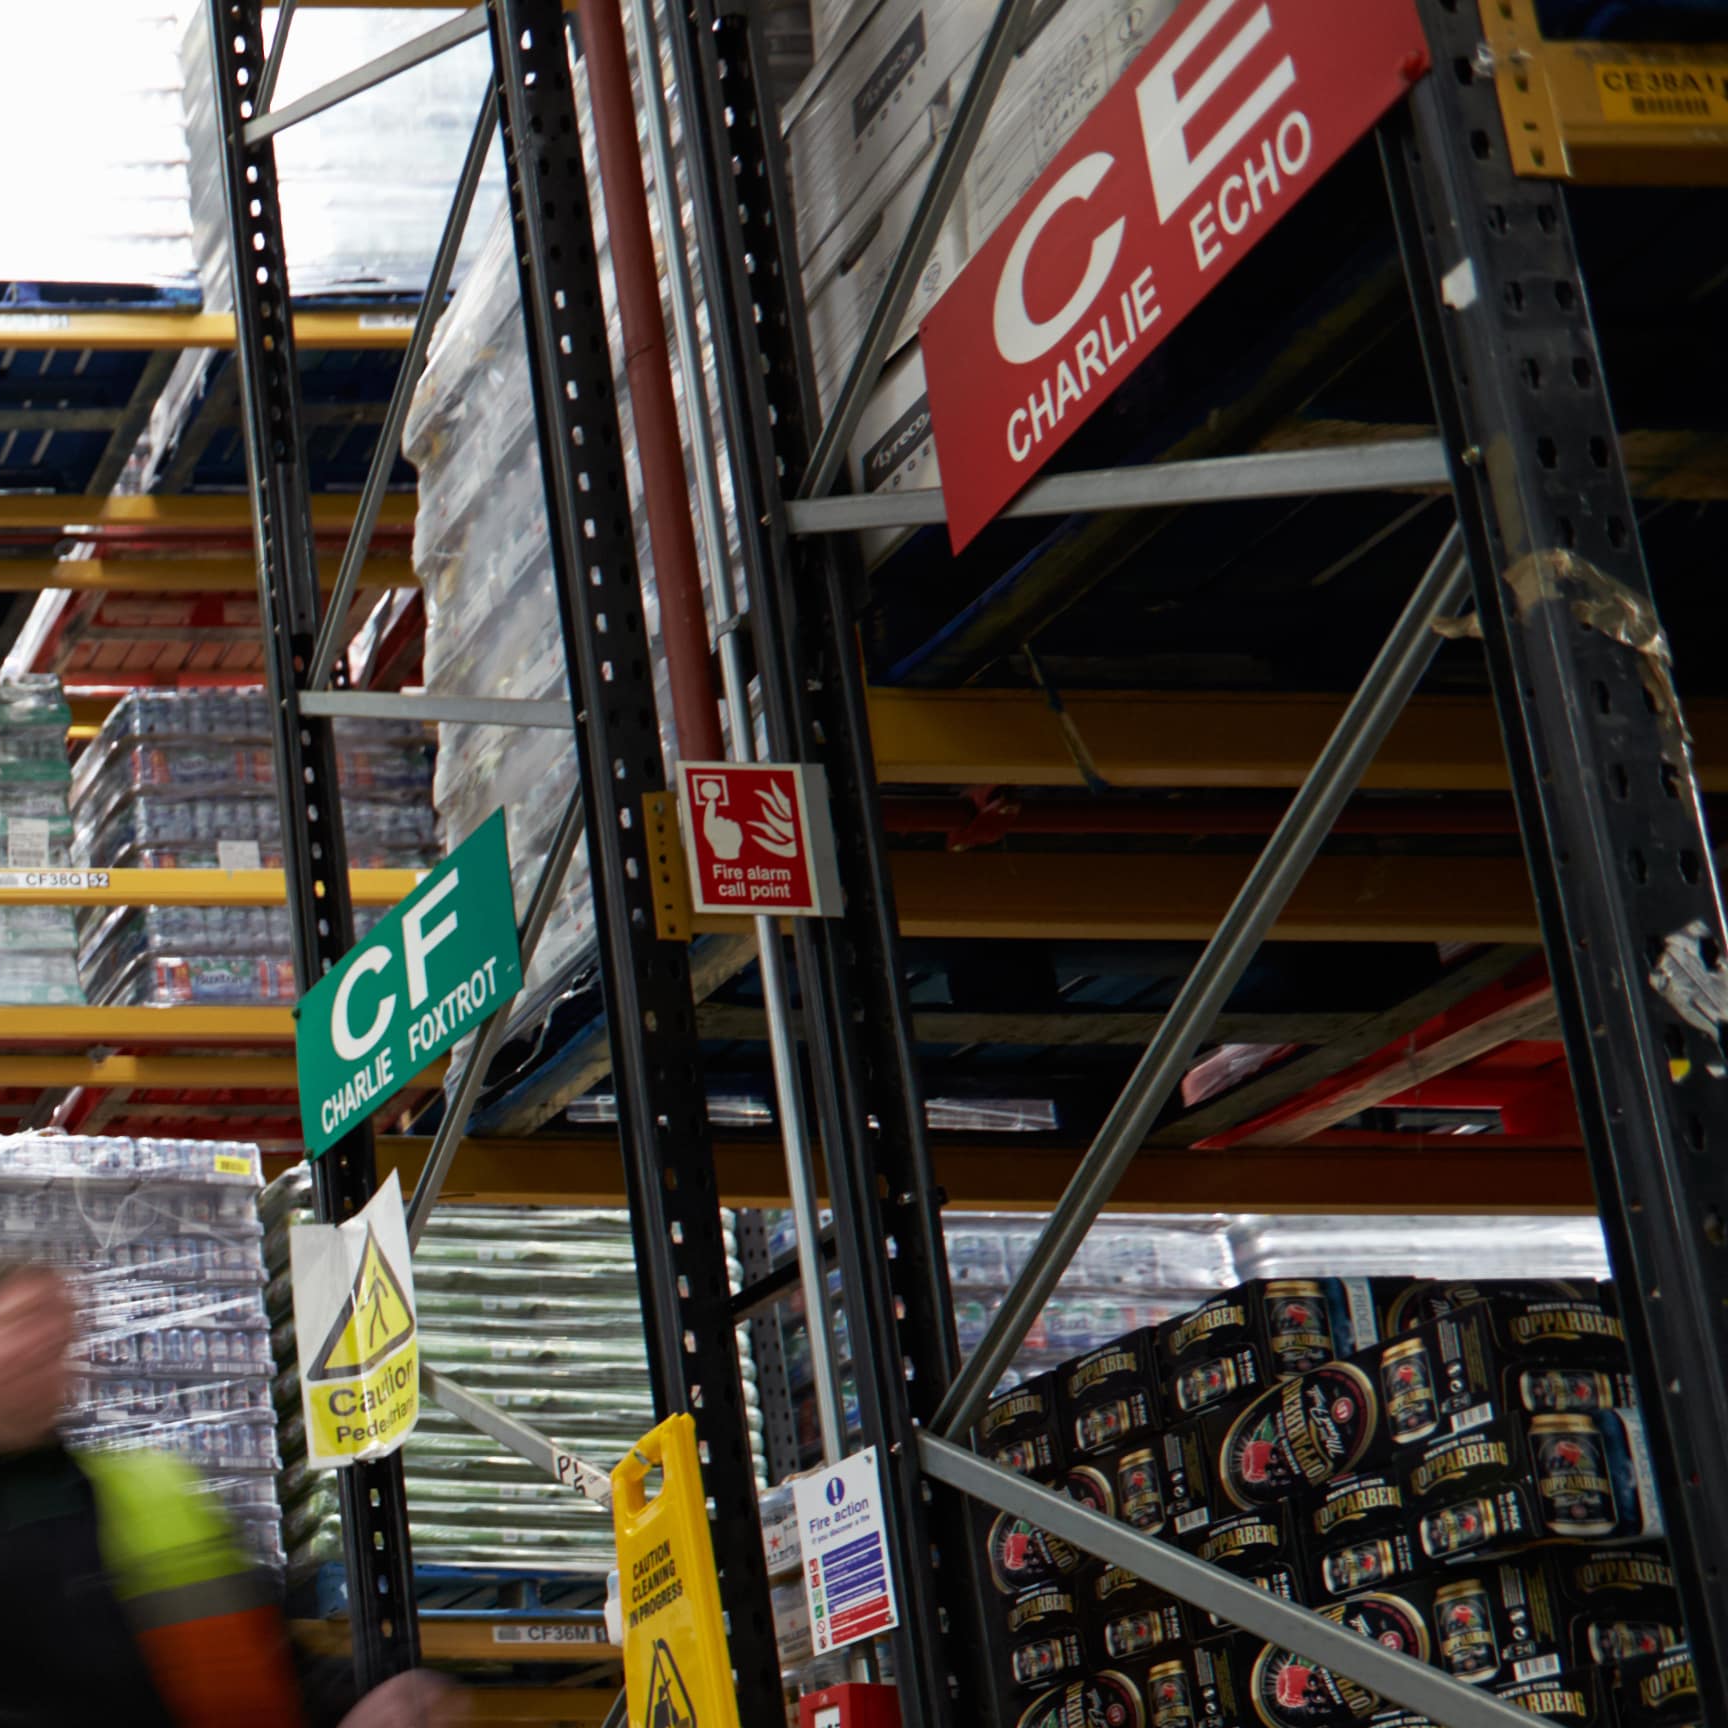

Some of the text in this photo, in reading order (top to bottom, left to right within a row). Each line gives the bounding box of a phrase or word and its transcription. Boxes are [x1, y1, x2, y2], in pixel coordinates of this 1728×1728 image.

[993, 0, 1296, 366] CE
[1006, 267, 1162, 463] CHARLIE
[1187, 110, 1313, 273] ECHO
[26, 873, 109, 887] CF38Q 52
[713, 864, 791, 880] Fire alarm
[719, 882, 791, 900] call point
[332, 867, 459, 1061] CF
[321, 956, 497, 1134] CHARLIE FOXTROT
[329, 1358, 414, 1416] Caution
[809, 1498, 869, 1534] Fire action
[632, 1558, 676, 1603] CLEANING
[633, 1538, 670, 1580] CAUTION
[639, 1578, 682, 1622] PROGRESS
[528, 1625, 590, 1640] CF36M
